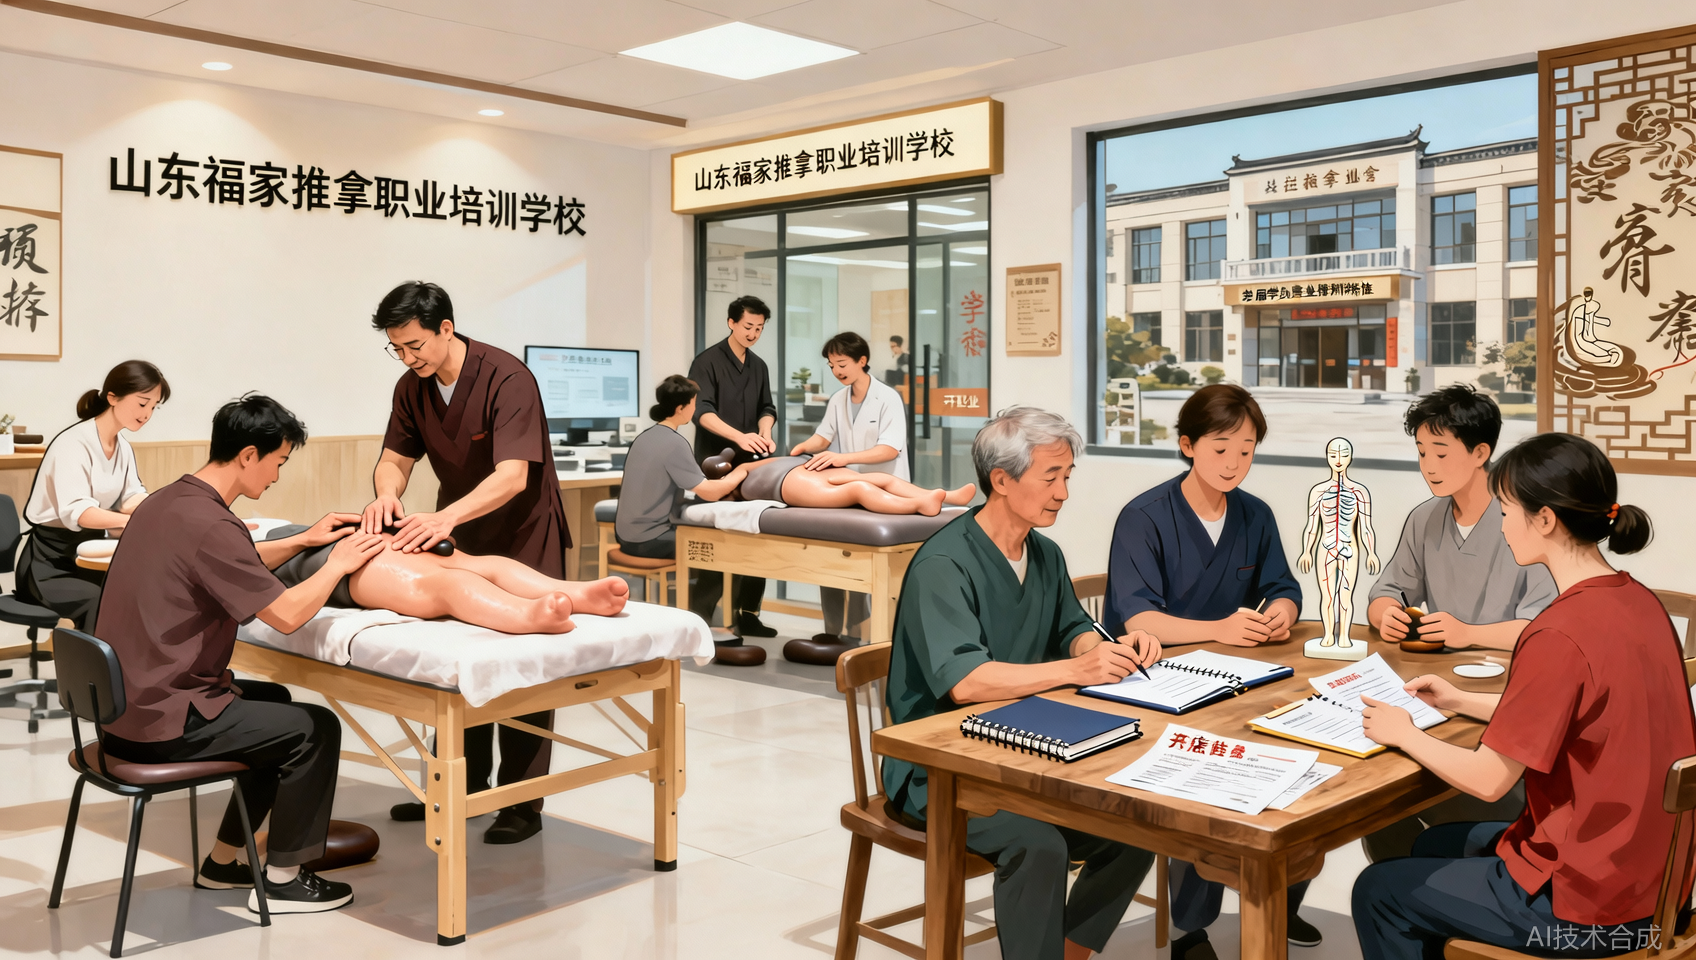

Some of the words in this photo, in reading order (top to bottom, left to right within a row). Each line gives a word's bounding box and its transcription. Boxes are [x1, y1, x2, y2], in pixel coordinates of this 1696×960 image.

[109, 147, 588, 237] 山东福家推拿职业培训学校
[694, 127, 956, 192] 山东福家推拿职业培训学校
